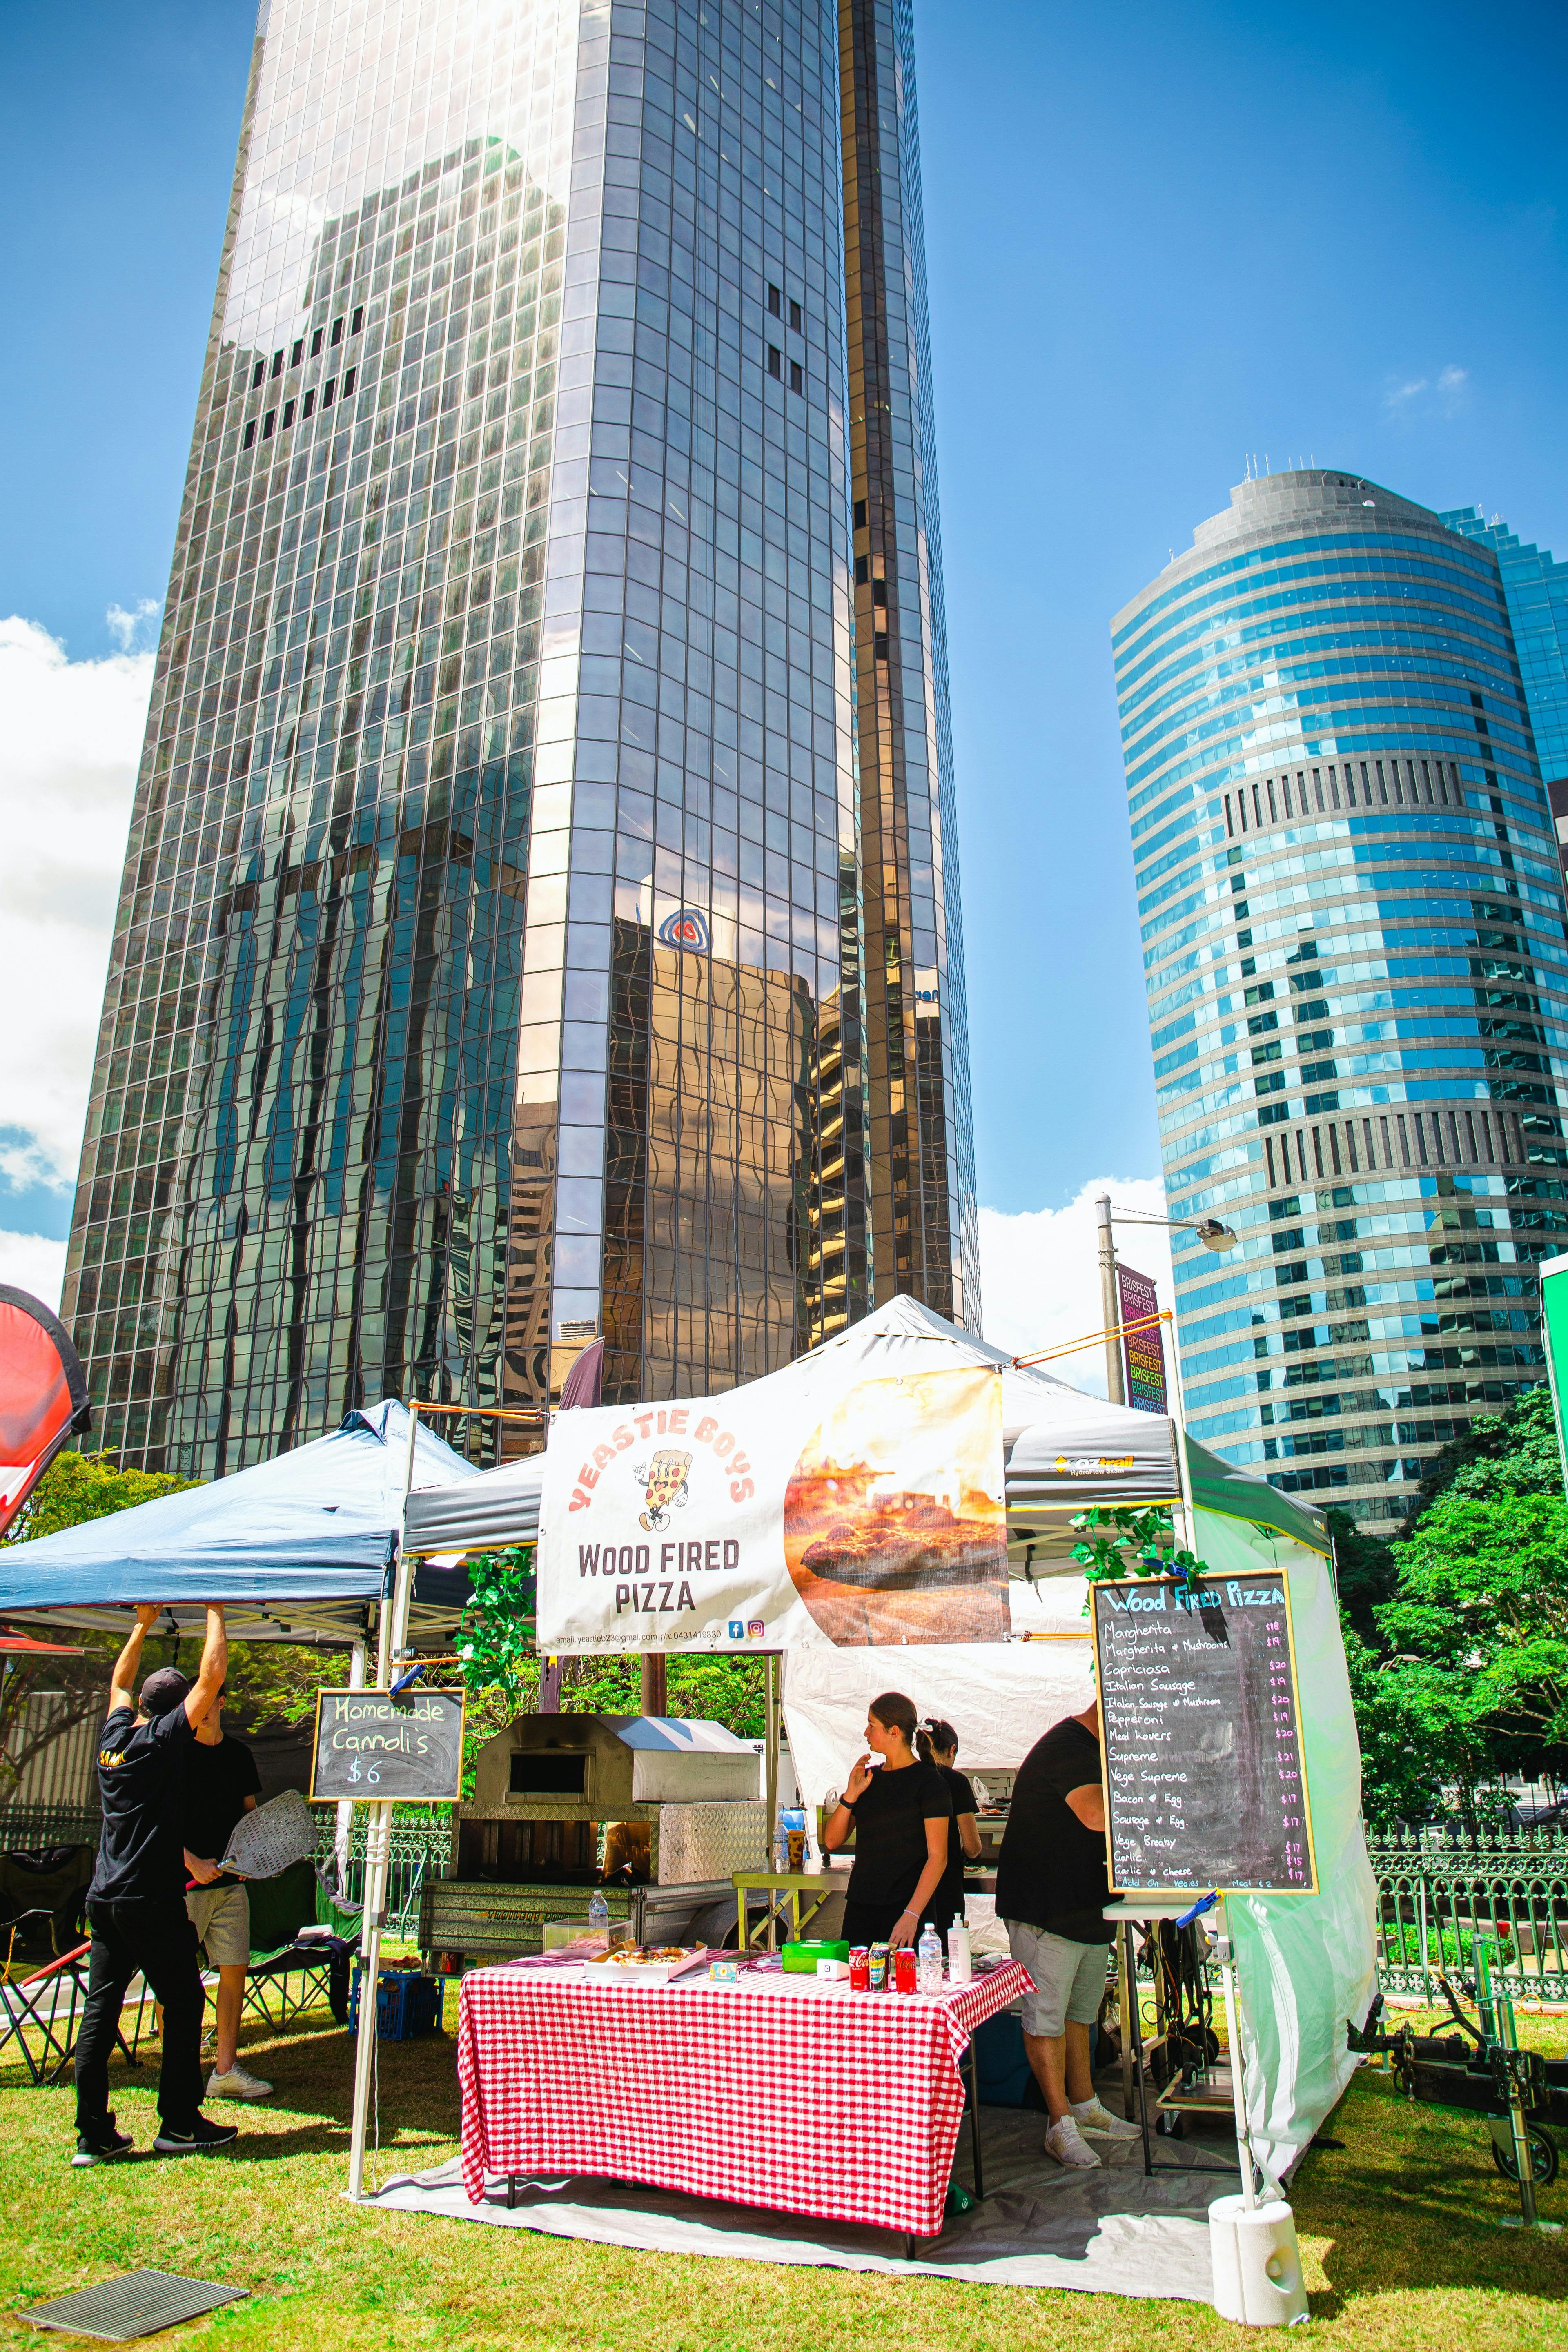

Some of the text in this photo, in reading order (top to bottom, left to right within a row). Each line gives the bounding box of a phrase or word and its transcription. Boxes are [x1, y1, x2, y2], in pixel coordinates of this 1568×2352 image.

[1121, 1274, 1152, 1300] BRISFEST
[1123, 1289, 1154, 1314] BRISFEST
[1128, 1334, 1160, 1358] BRISFEST
[1129, 1350, 1161, 1373] BRISFEST
[1130, 1365, 1163, 1388] BRISFEST
[1131, 1380, 1164, 1403] BRISFEST
[569, 1409, 755, 1512] YEASTIE BOYS
[579, 1539, 739, 1577] WOOD FIRED
[616, 1581, 696, 1613] PIZZA
[1102, 1586, 1165, 1612] Wood
[556, 1635, 576, 1644] email:
[577, 1633, 657, 1644] yeastieb23@gmail.com
[661, 1633, 672, 1642] ph:
[673, 1630, 721, 1639] 0431419830
[1104, 1620, 1279, 1644] Margherita $18
[1105, 1642, 1165, 1660] Margherita
[1183, 1639, 1227, 1651] Mushrooms
[1267, 1636, 1280, 1647] $19
[1104, 1660, 1286, 1680] Capriciosa $20
[1104, 1677, 1286, 1695] Italian Sausage $19
[335, 1694, 445, 1723] Homemade
[1104, 1697, 1135, 1709] Italian
[1139, 1697, 1168, 1712] Sausage
[1183, 1696, 1220, 1706] Mushroom
[1272, 1694, 1290, 1705] $20
[1108, 1711, 1289, 1728] Pepperoni $19
[1276, 1728, 1294, 1739] $20
[1109, 1746, 1294, 1765] Supreme $21
[1110, 1766, 1298, 1787] Vege Supreme $20
[1113, 1791, 1143, 1804] Bacon
[1281, 1793, 1297, 1805] $17
[1112, 1811, 1150, 1831] Sausage
[1283, 1815, 1300, 1829] $17
[1114, 1832, 1136, 1850] Vege
[1285, 1840, 1301, 1854] $17
[1287, 1855, 1303, 1867] $15
[1114, 1864, 1142, 1875] Garlic
[1288, 1868, 1304, 1881] $17
[1122, 1875, 1140, 1887] Add
[1147, 1879, 1159, 1887] On
[488, 1910, 540, 1922] TRAILERS
